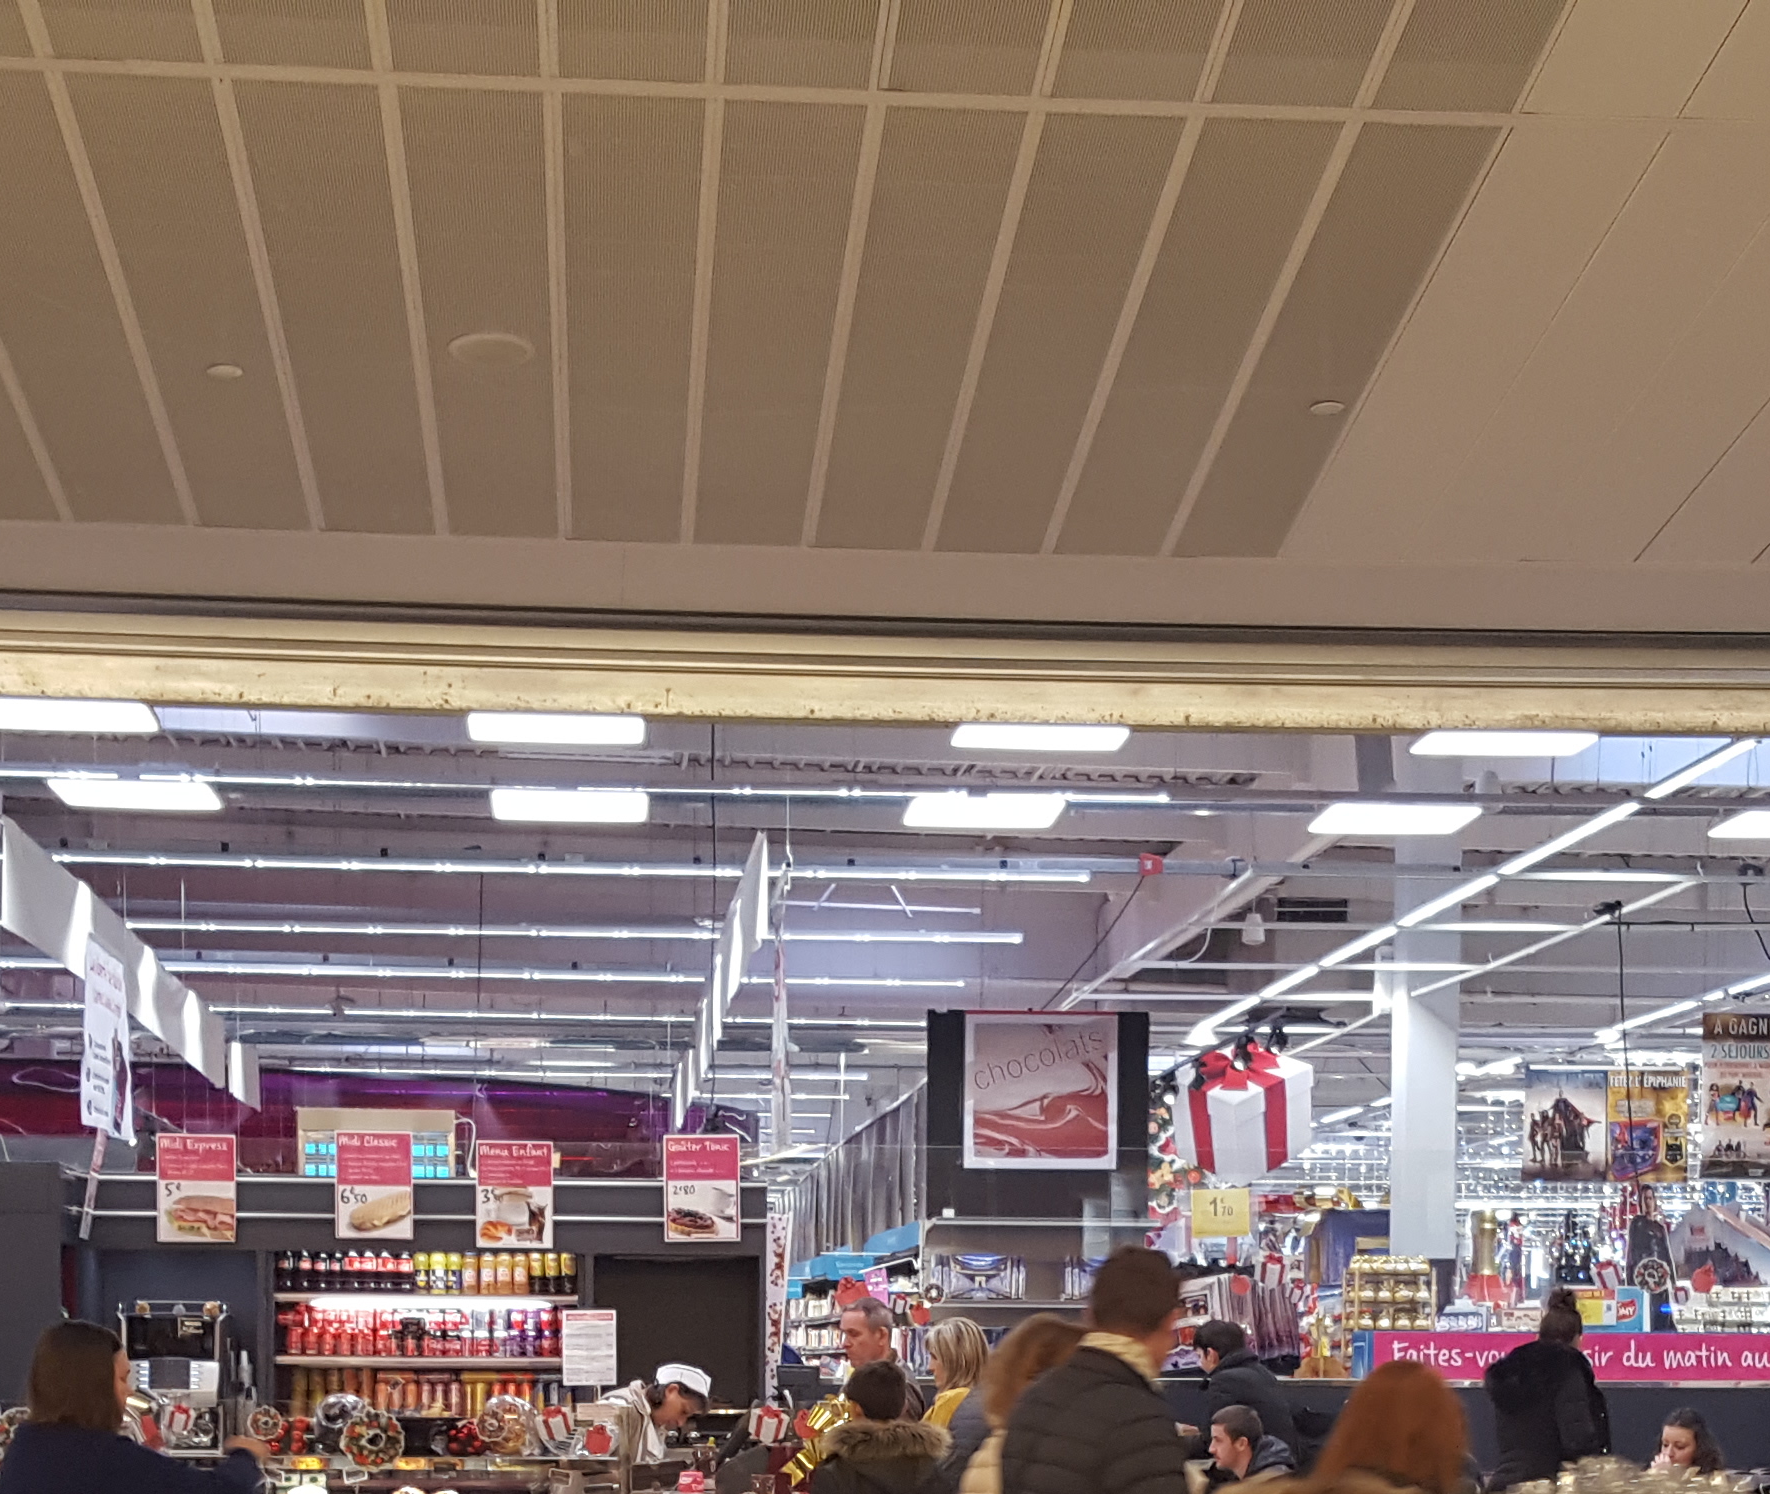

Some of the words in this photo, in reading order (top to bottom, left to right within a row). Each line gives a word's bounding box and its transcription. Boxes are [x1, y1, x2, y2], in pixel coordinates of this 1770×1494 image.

[974, 1029, 1102, 1091] chocolats
[1392, 1340, 1506, 1368] Faites-vou
[1622, 1338, 1656, 1368] du
[1663, 1342, 1732, 1370] matin
